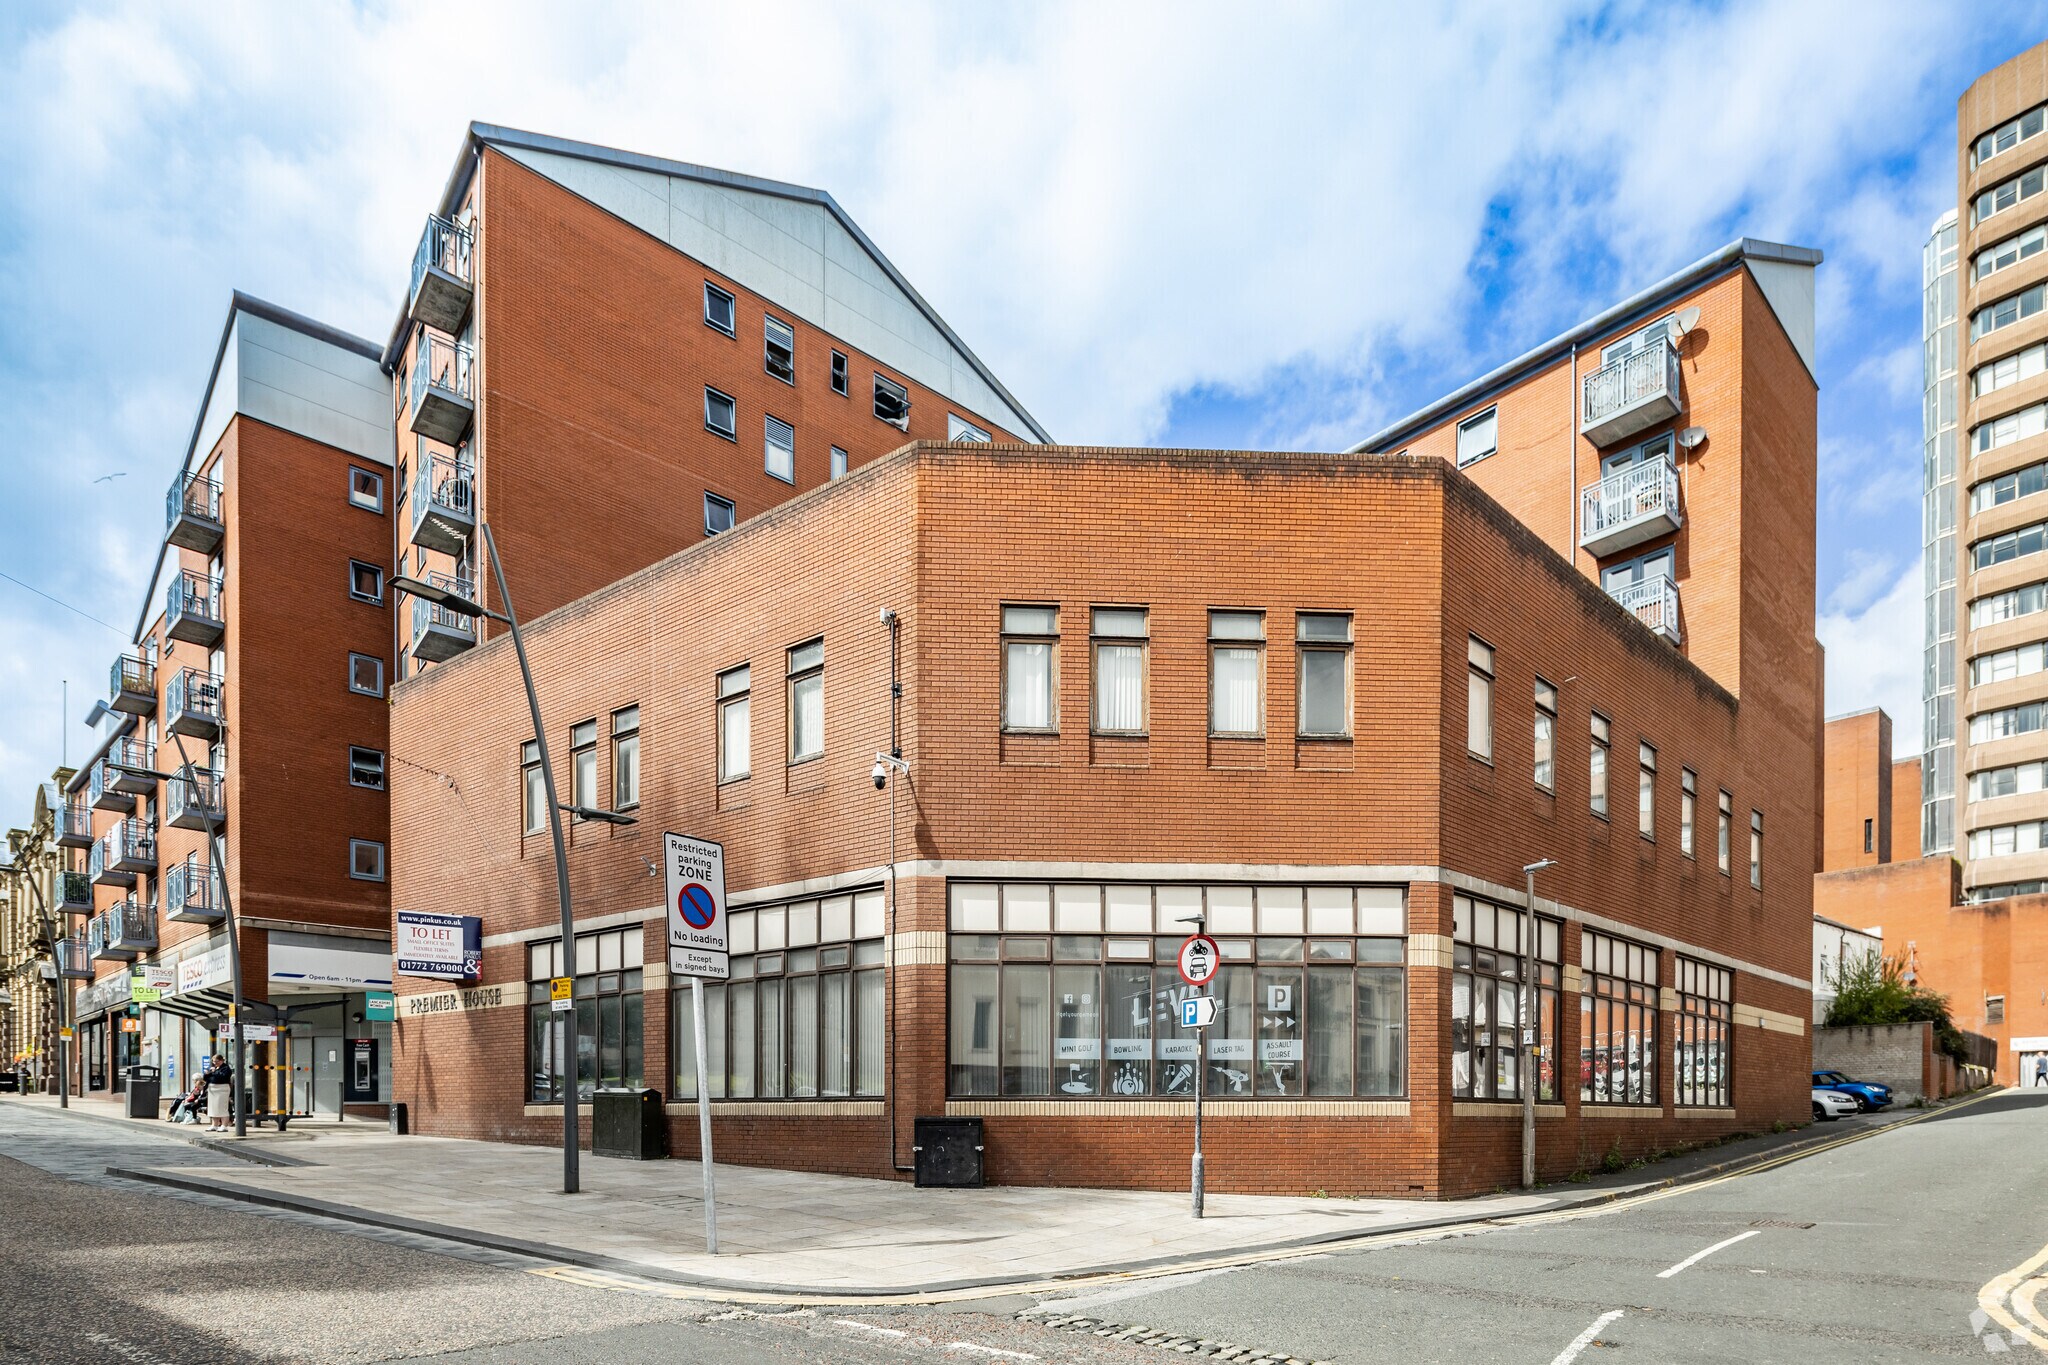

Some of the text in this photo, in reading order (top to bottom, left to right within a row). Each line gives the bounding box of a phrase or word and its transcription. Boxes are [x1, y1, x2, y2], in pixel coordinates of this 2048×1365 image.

[671, 840, 718, 858] Restricted
[678, 855, 712, 870] parking
[678, 865, 712, 882] ZONE
[401, 915, 462, 926] www.pinkus.co.uk
[410, 926, 452, 940] TO LET
[674, 930, 723, 947] No loading
[688, 953, 712, 964] Except
[182, 960, 203, 982] TESCO
[400, 961, 463, 972] 01772 769000
[675, 961, 725, 974] in signed bays
[410, 987, 502, 1014] PREMIER HOUSE
[1275, 988, 1286, 1008] P
[1185, 1003, 1196, 1024] P
[1061, 1044, 1094, 1053] MINI GOLF
[1113, 1045, 1143, 1054] BOWLING
[1165, 1045, 1193, 1054] KARAOKE
[1213, 1045, 1233, 1054] LASER
[1266, 1041, 1292, 1049] ASSAULT
[1267, 1051, 1291, 1059] COURSE
